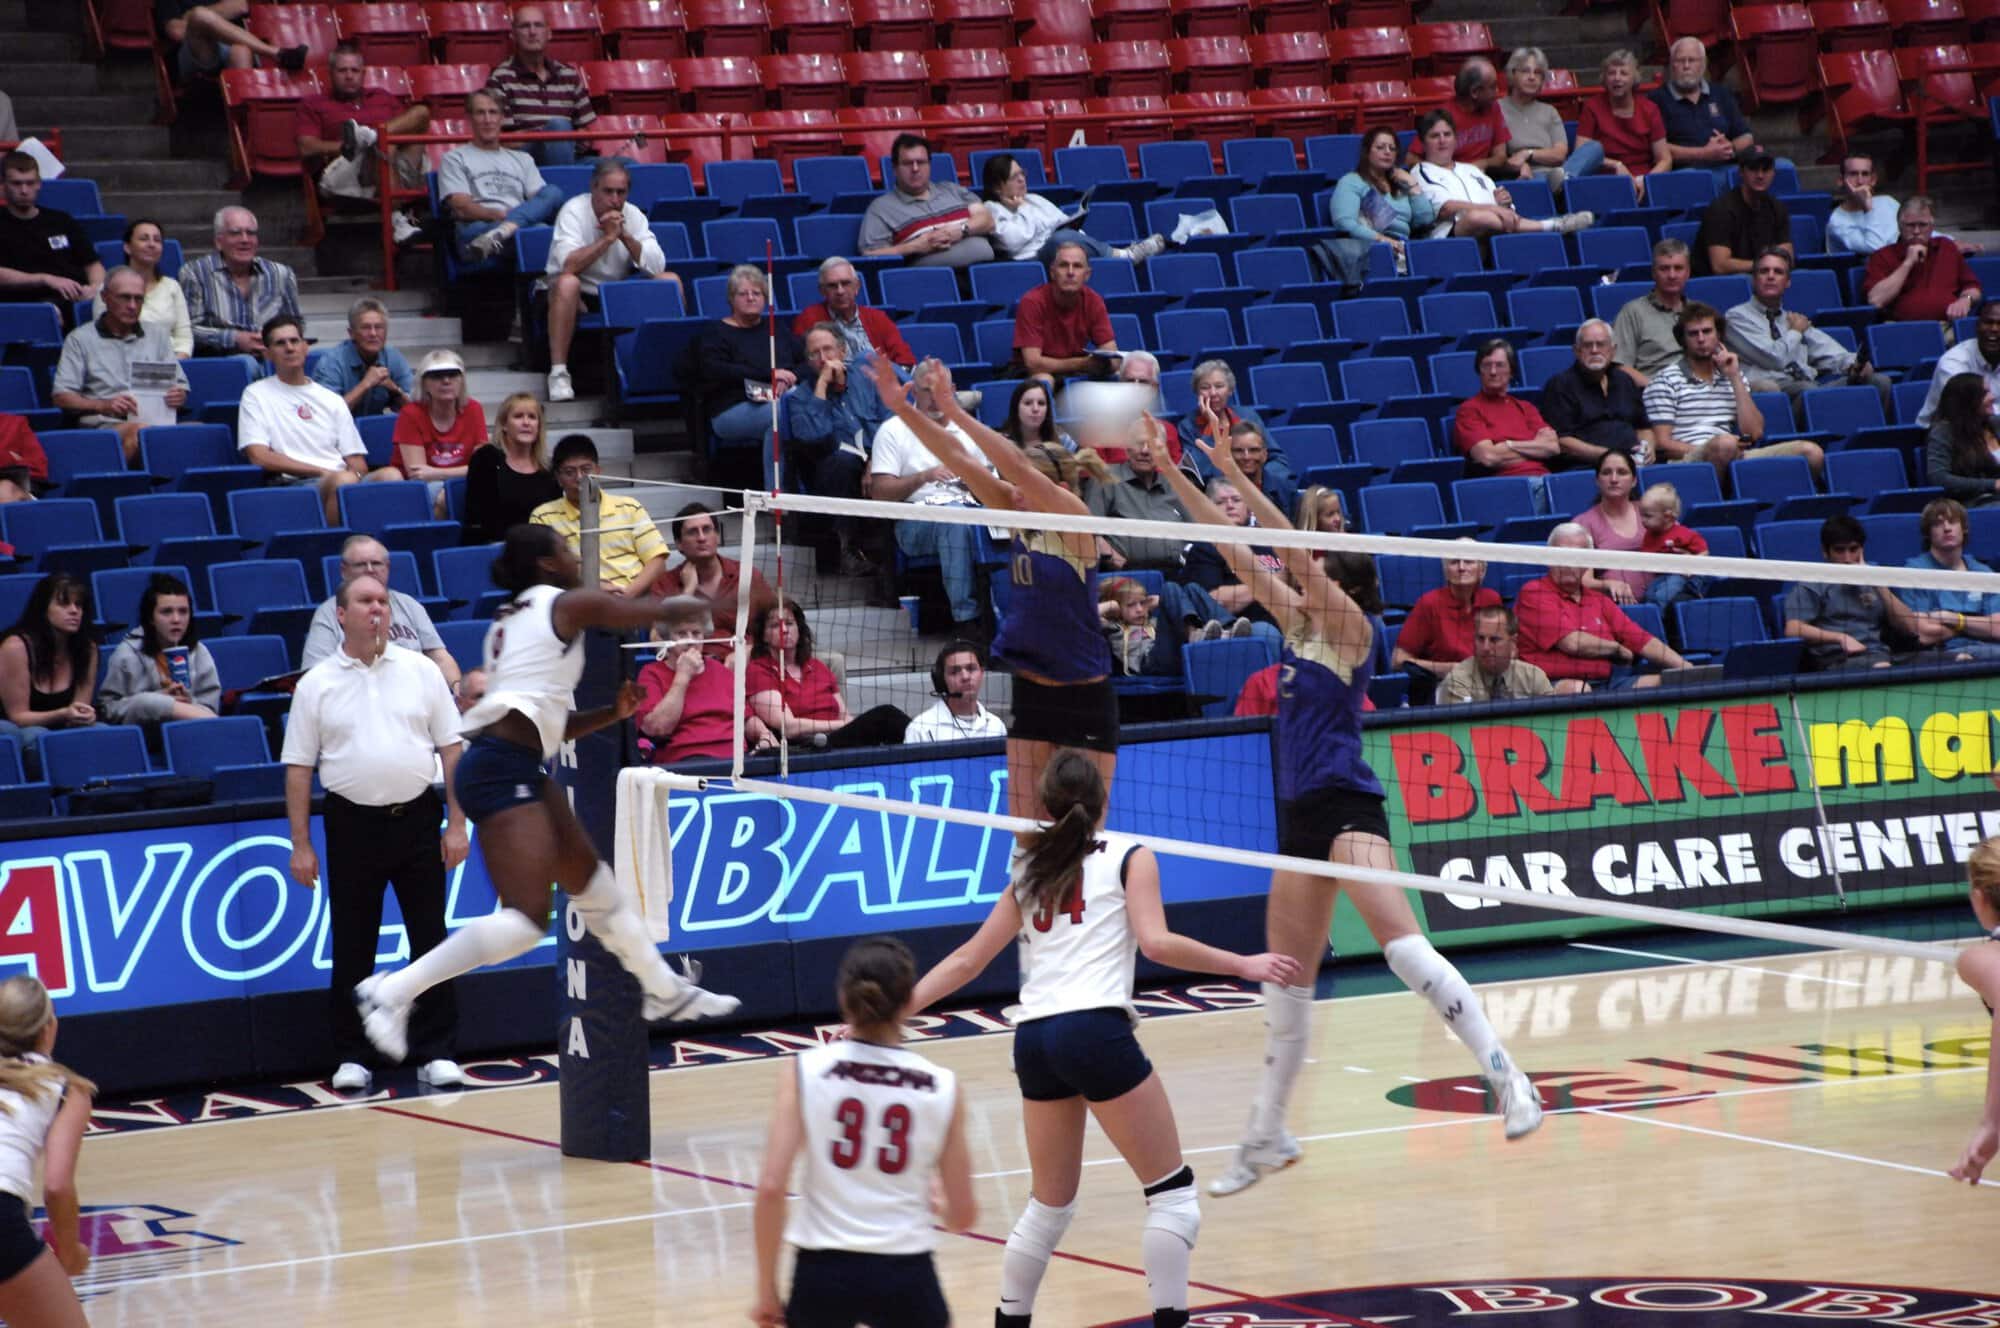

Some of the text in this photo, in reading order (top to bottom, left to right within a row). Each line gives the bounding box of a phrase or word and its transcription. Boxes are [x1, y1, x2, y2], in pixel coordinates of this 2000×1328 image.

[1011, 553, 1033, 586] 10
[1390, 703, 2000, 825] BRAKE ma
[1440, 810, 2000, 910] CAR CARE CENTE
[830, 1097, 912, 1175] 33
